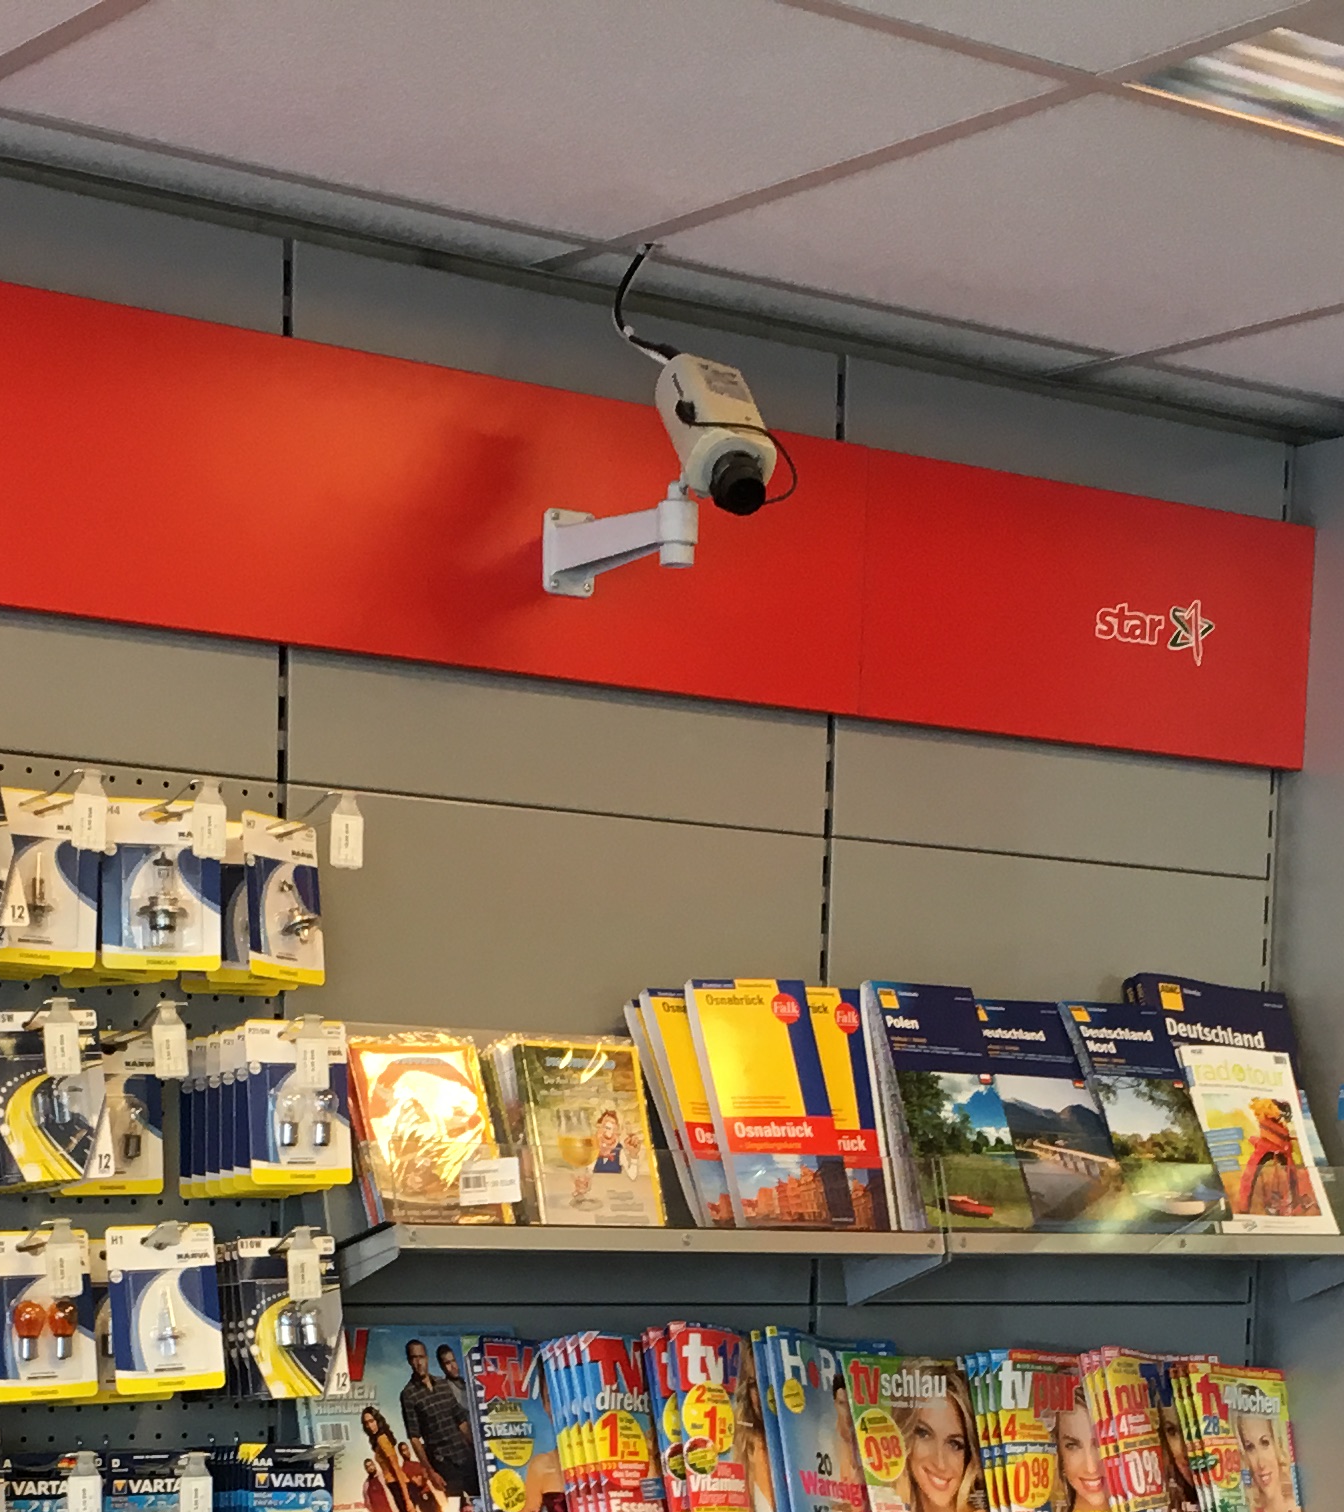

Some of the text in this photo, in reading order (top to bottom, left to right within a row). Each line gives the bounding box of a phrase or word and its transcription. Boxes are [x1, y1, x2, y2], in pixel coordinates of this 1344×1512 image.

[1095, 603, 1164, 645] star
[705, 994, 763, 1006] Osnabrück
[772, 999, 800, 1017] Falk
[886, 1015, 919, 1031] Polen
[1080, 1025, 1153, 1043] Deutschland
[1165, 1018, 1264, 1050] Deutschland
[1088, 1040, 1116, 1054] Nord
[734, 1123, 813, 1139] Osnabrück
[596, 1385, 649, 1413] direkt
[271, 1473, 324, 1488] VARTA
[691, 1475, 747, 1492] Vitamine
